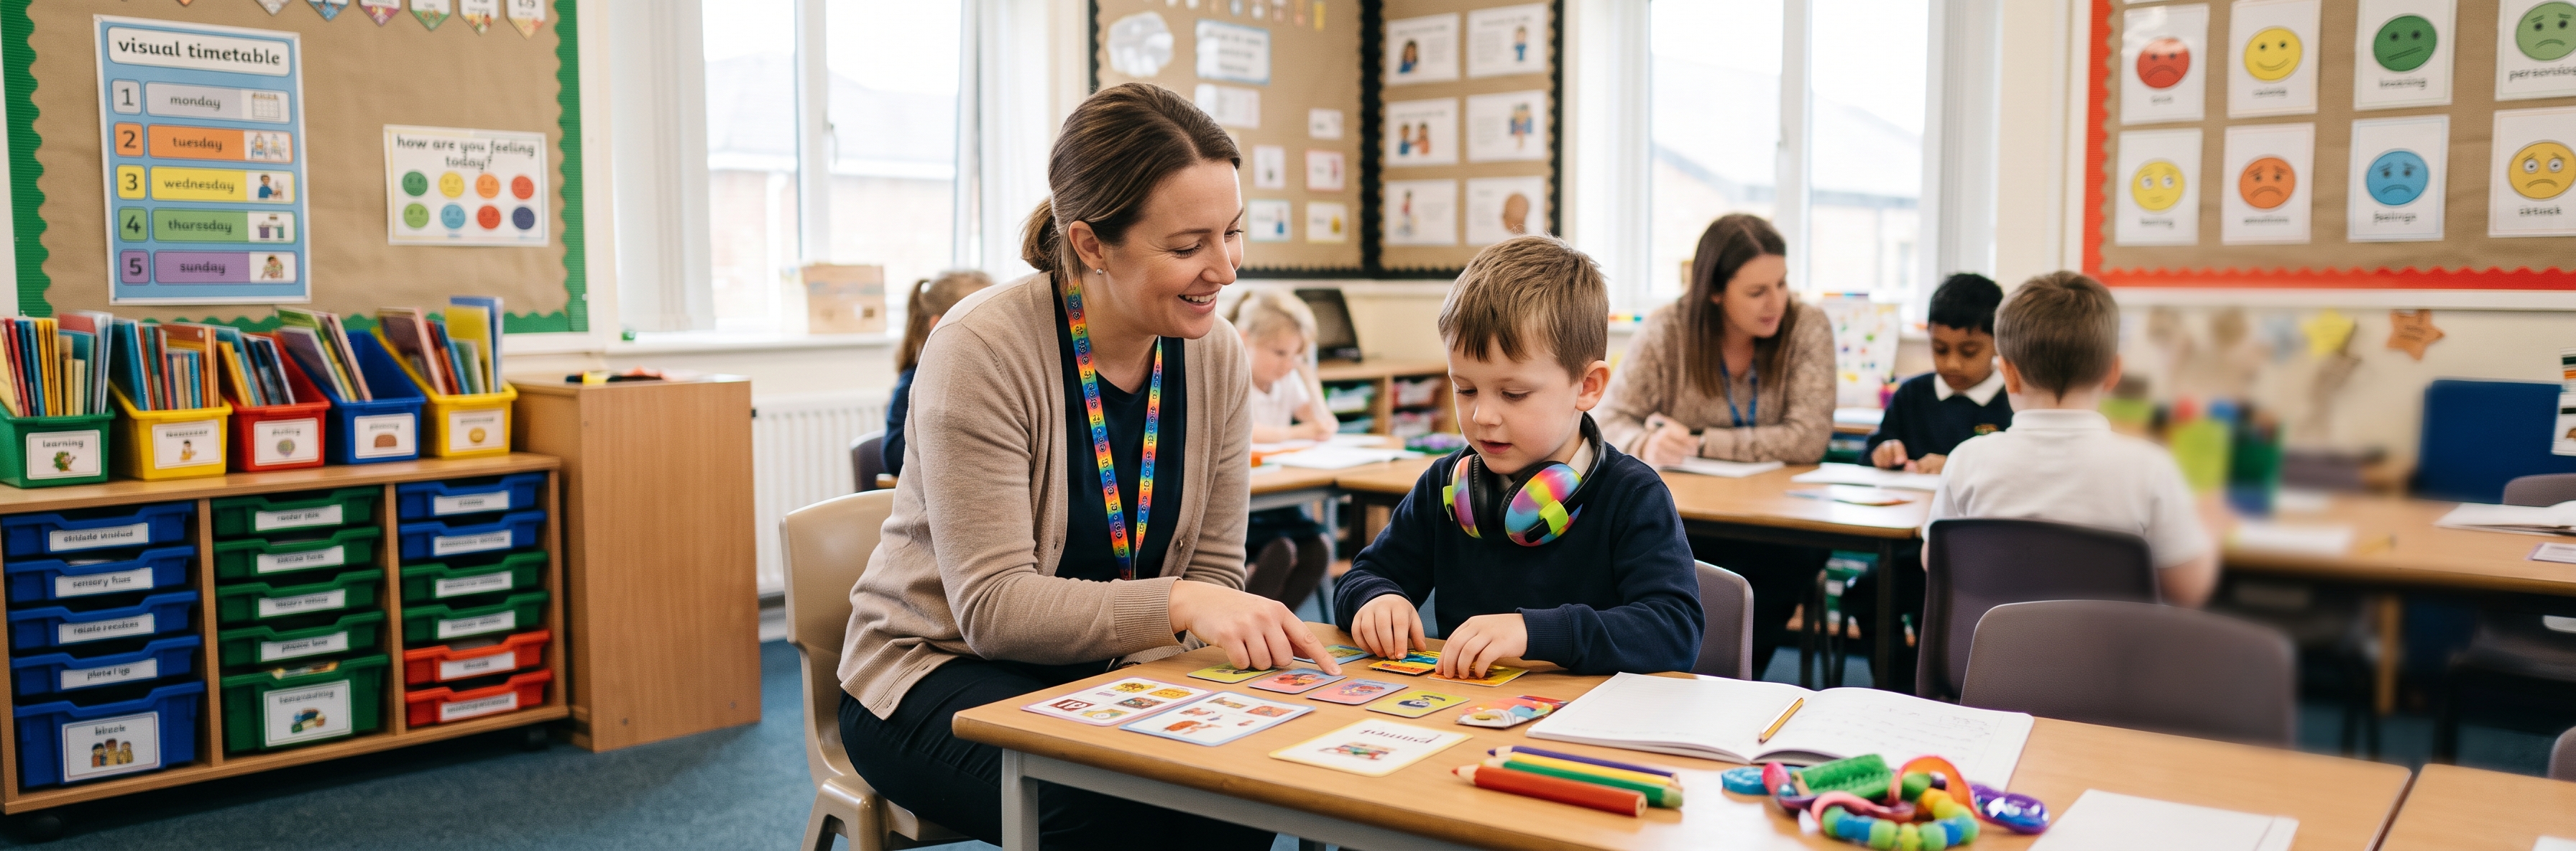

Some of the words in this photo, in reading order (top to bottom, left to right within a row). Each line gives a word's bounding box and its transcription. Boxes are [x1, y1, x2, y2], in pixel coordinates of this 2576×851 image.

[118, 38, 180, 56] visual
[188, 43, 280, 65] timetable
[121, 88, 134, 106] 1
[170, 96, 221, 111] monday
[122, 130, 137, 148] 2
[172, 137, 222, 152] tuesday
[397, 134, 427, 149] how
[433, 139, 455, 150] are
[460, 140, 484, 155] you
[489, 140, 535, 157] feeling
[446, 155, 492, 172] today?
[125, 172, 137, 191] 3
[164, 178, 234, 193] wednesday
[126, 215, 141, 234] 4
[129, 257, 142, 276] 5
[180, 262, 226, 275] sunday
